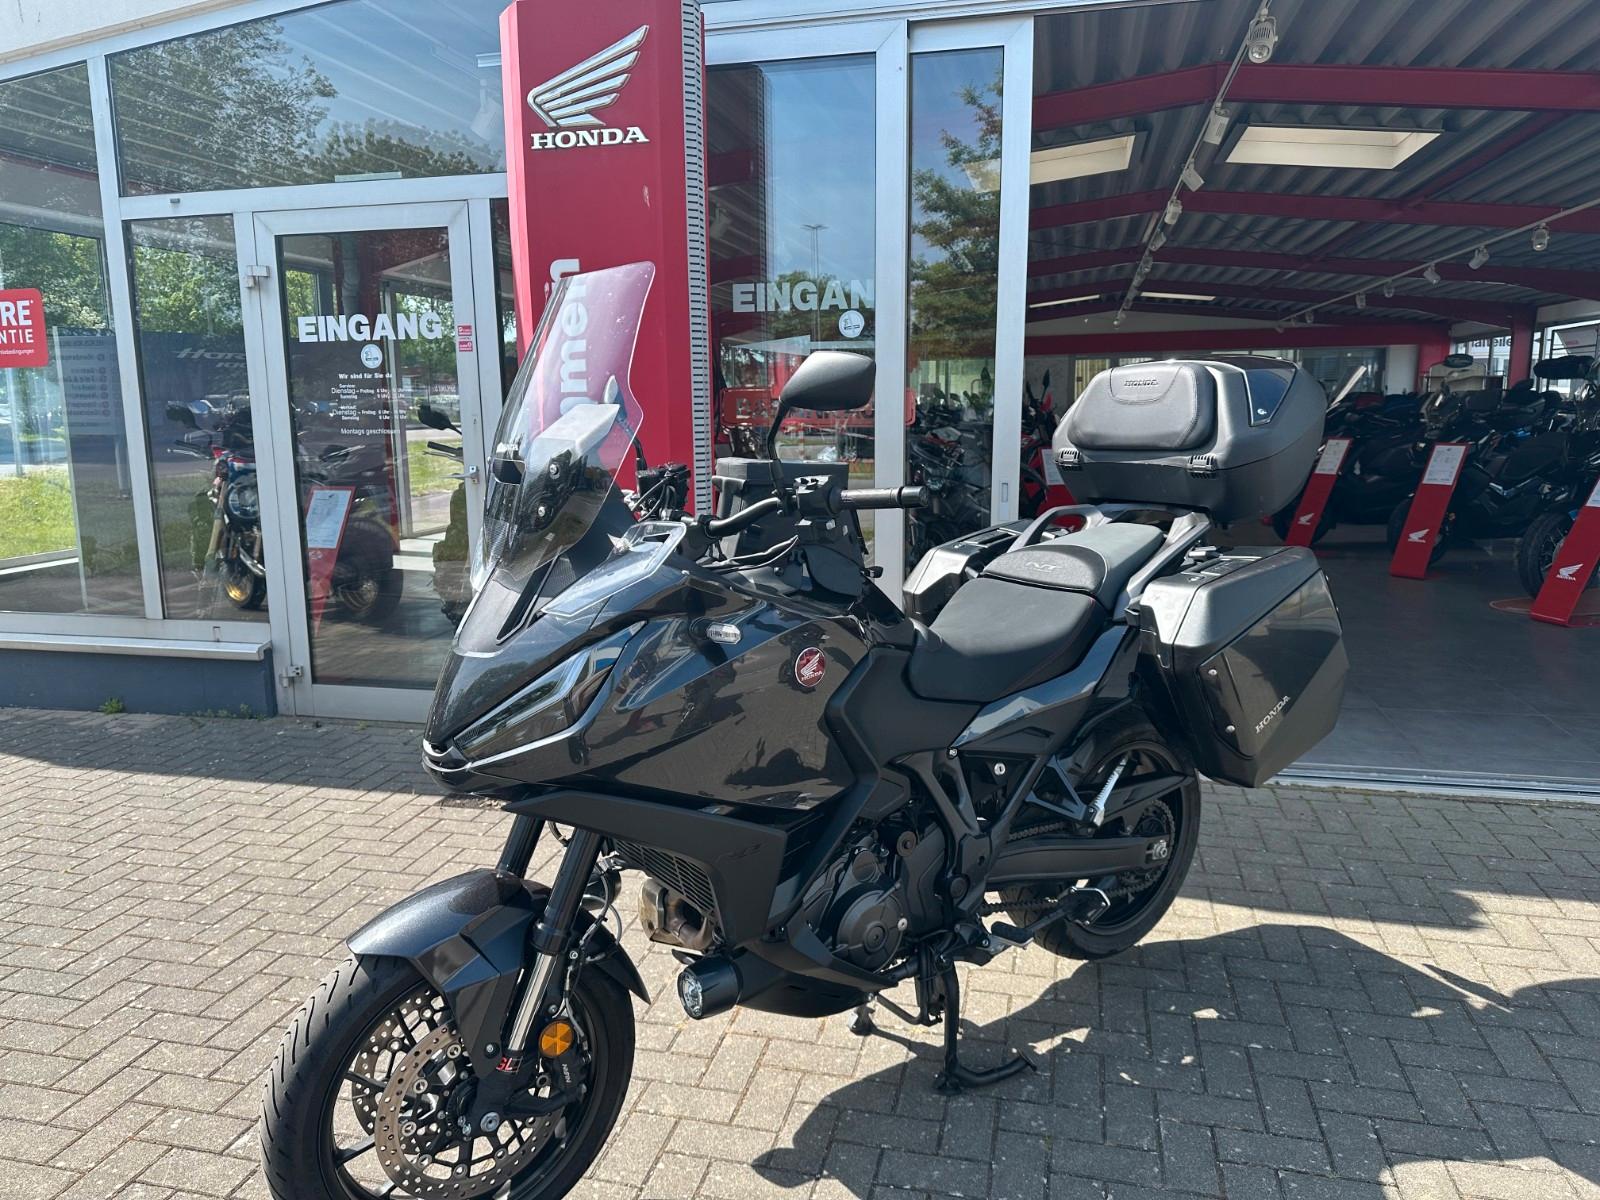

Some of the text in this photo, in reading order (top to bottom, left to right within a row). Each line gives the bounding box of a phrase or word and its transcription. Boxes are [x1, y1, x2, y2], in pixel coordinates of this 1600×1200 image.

[530, 126, 650, 150] HONDA
[732, 279, 876, 313] EINGAN
[297, 311, 443, 343] EINGANG
[801, 670, 823, 681] HONDA
[1255, 695, 1290, 734] HONDA
